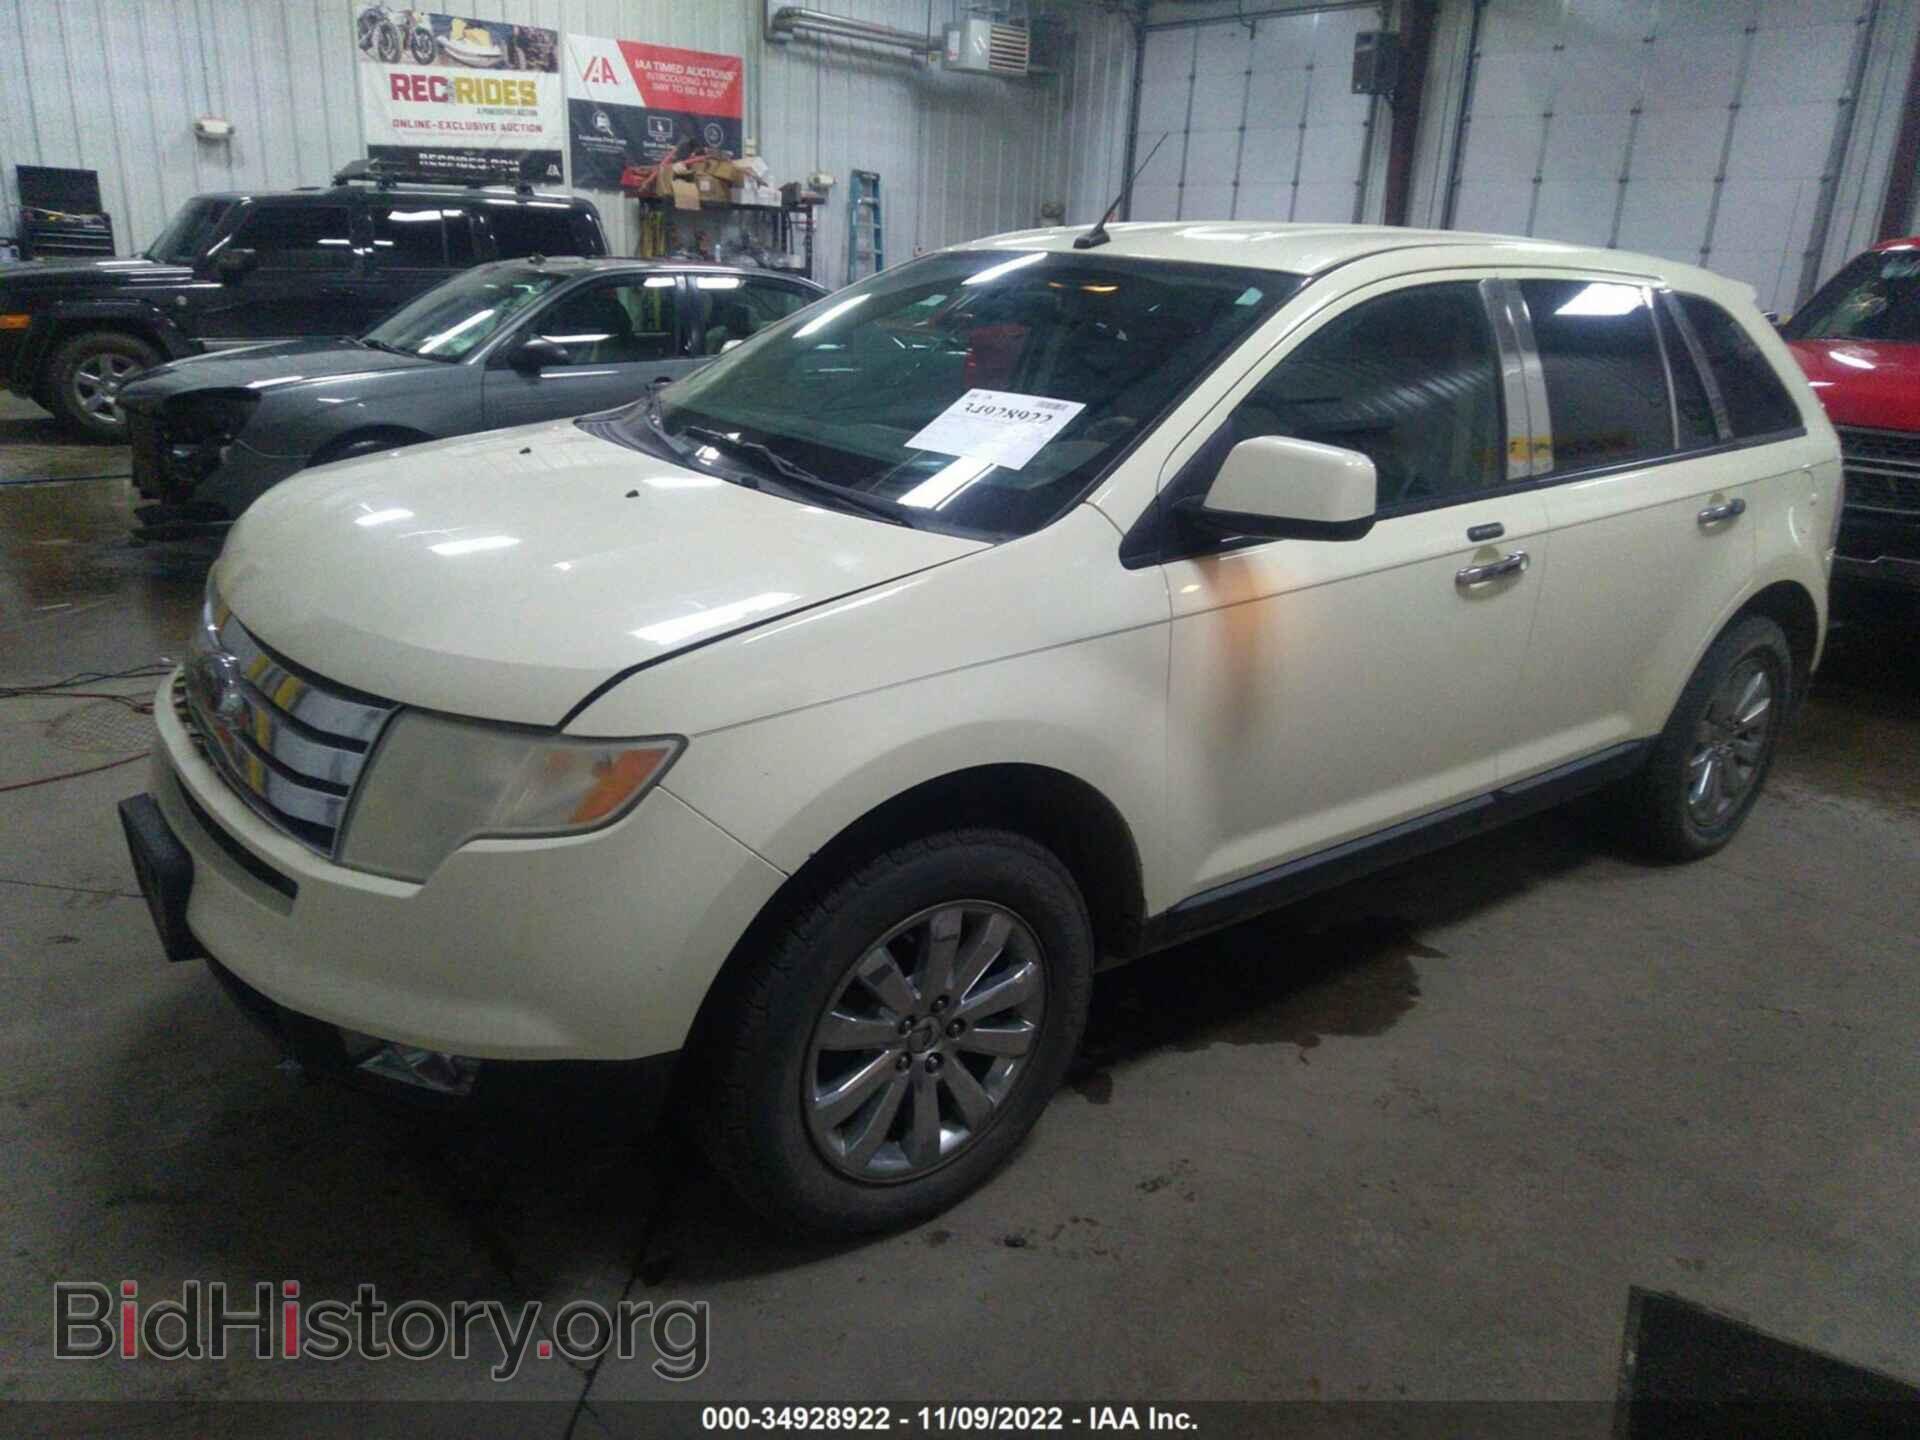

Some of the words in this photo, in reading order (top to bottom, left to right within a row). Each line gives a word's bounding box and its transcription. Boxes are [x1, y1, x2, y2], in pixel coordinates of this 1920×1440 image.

[653, 61, 684, 75] TIMED
[390, 73, 448, 103] REC
[454, 76, 537, 106] RIDES
[392, 118, 497, 133] ONLINE-EXCLUSIVE
[501, 122, 543, 133] AUCTION
